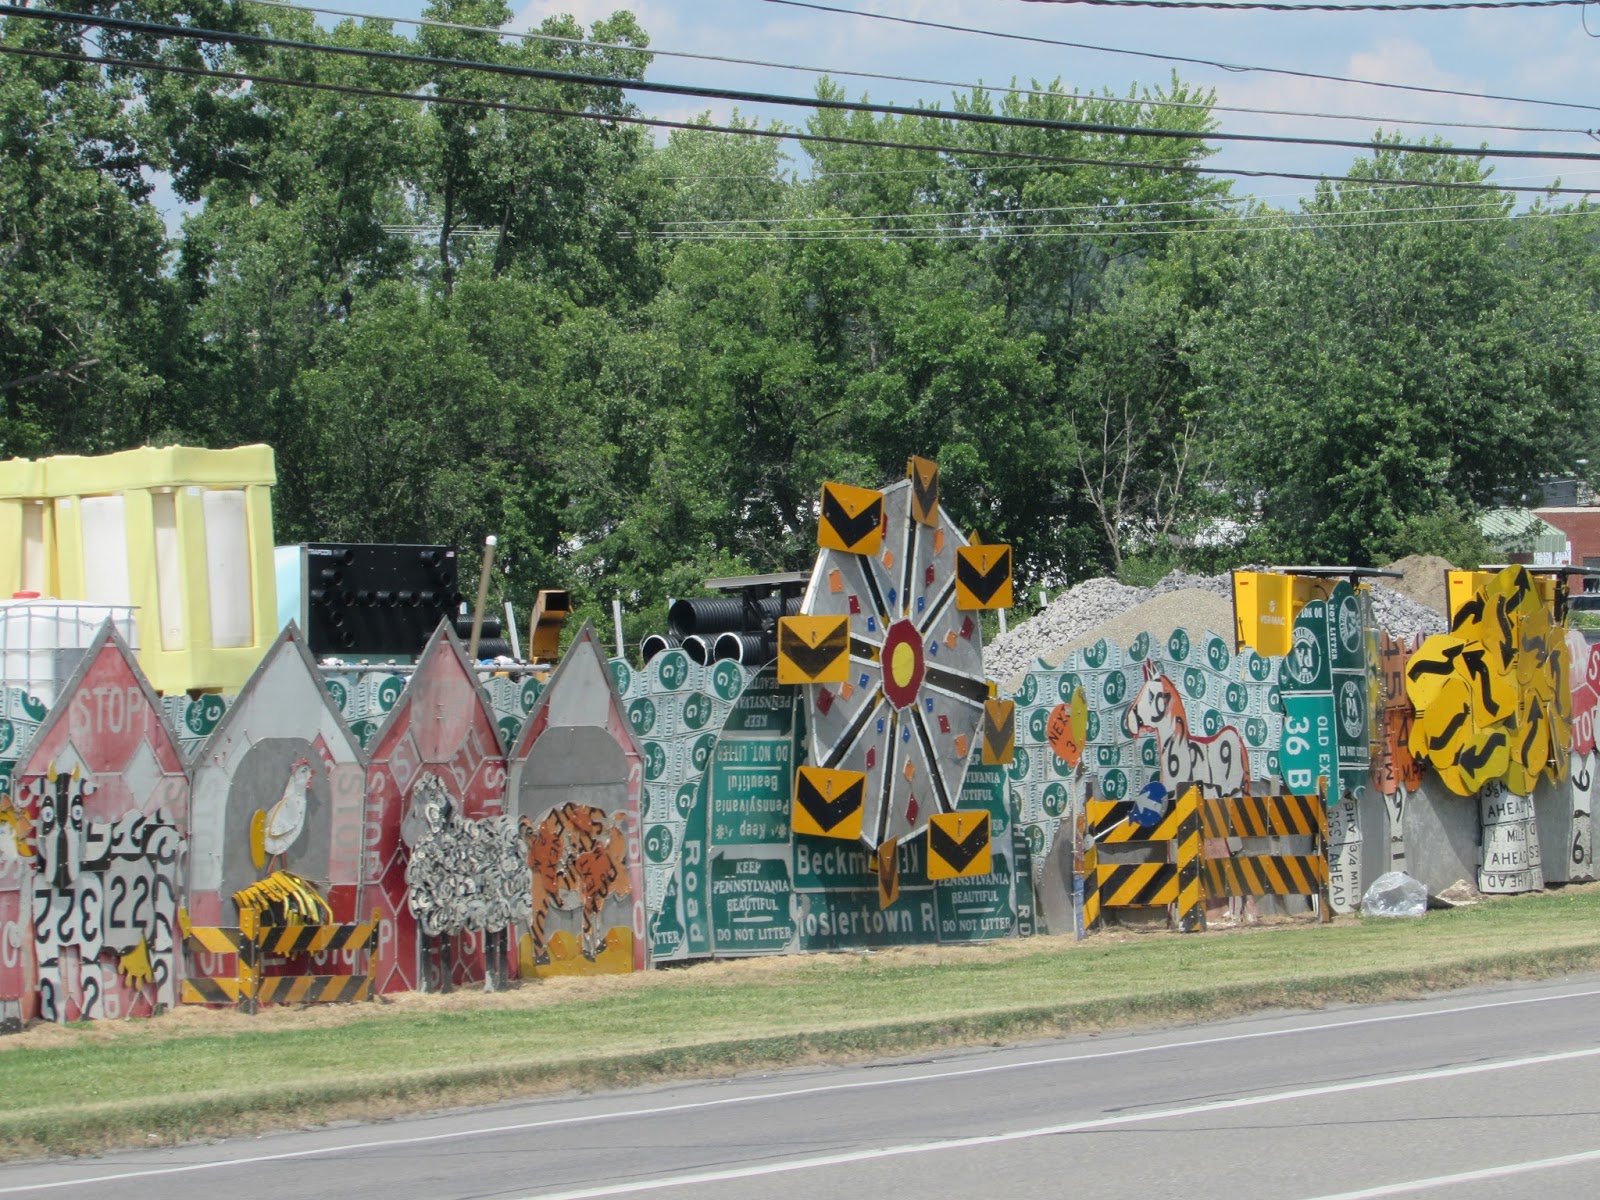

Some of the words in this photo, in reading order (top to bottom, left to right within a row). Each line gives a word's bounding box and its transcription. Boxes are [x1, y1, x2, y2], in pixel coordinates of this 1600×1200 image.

[1314, 607, 1323, 618] DO
[1131, 640, 1140, 652] G
[1170, 638, 1180, 651] G
[1330, 627, 1338, 660] LITTER
[1086, 646, 1096, 658] G
[1210, 647, 1219, 659] G
[1296, 647, 1313, 667] PA
[662, 665, 674, 678] G
[1251, 659, 1260, 671] G
[717, 672, 728, 687] G
[1186, 674, 1196, 687] G
[1061, 681, 1071, 694] G
[1106, 683, 1116, 696] G
[383, 688, 397, 703] G
[524, 690, 535, 705] G
[1228, 690, 1238, 702] G
[1270, 693, 1279, 705] G
[77, 686, 143, 736] STOP
[206, 706, 221, 721] G
[686, 705, 698, 718] G
[1345, 697, 1359, 717] PA
[631, 710, 642, 724] G
[665, 697, 674, 735] SOUTH
[744, 714, 769, 728] KEEP
[1206, 717, 1215, 729] G
[1032, 719, 1043, 732] G
[1247, 724, 1256, 736] G
[1317, 715, 1329, 747] OLD
[1284, 715, 1311, 756] 36
[752, 745, 771, 762] NOT
[776, 745, 789, 761] DO
[1067, 740, 1077, 753] 3
[1144, 748, 1153, 760] G
[696, 747, 707, 762] G
[1100, 748, 1110, 761] G
[1167, 738, 1180, 779] 6
[1219, 740, 1232, 780] 9
[1268, 756, 1278, 768] G
[728, 775, 778, 791] Beautiful
[1105, 780, 1116, 792] G
[1287, 768, 1312, 789] B
[1339, 777, 1346, 791] DO
[679, 794, 690, 808] G
[716, 795, 789, 815] Pennsylvania
[1045, 794, 1056, 807] G
[1343, 790, 1357, 834] AHEA
[740, 820, 766, 839] Keep
[1507, 829, 1525, 843] MILE
[648, 838, 659, 851] G
[1572, 829, 1585, 865] 6
[797, 844, 872, 875] Beckm
[1013, 823, 1028, 884] HILL
[1348, 845, 1358, 866] 3/4
[736, 861, 761, 875] KEEP
[713, 879, 790, 895] PENNSYLVANIA
[1328, 853, 1346, 907] AHEAD
[685, 840, 705, 943] Road
[1350, 870, 1359, 906] MILE
[111, 875, 149, 929] 22
[726, 896, 779, 912] BEAUTIFUL
[952, 890, 999, 904] BEAUTIFUL
[943, 920, 957, 933] DO
[959, 919, 977, 932] NOT
[981, 916, 1011, 931] LITTER
[1018, 904, 1032, 937] RD
[717, 928, 731, 941] DO
[735, 928, 754, 941] NOT
[758, 926, 792, 940] LITTER
